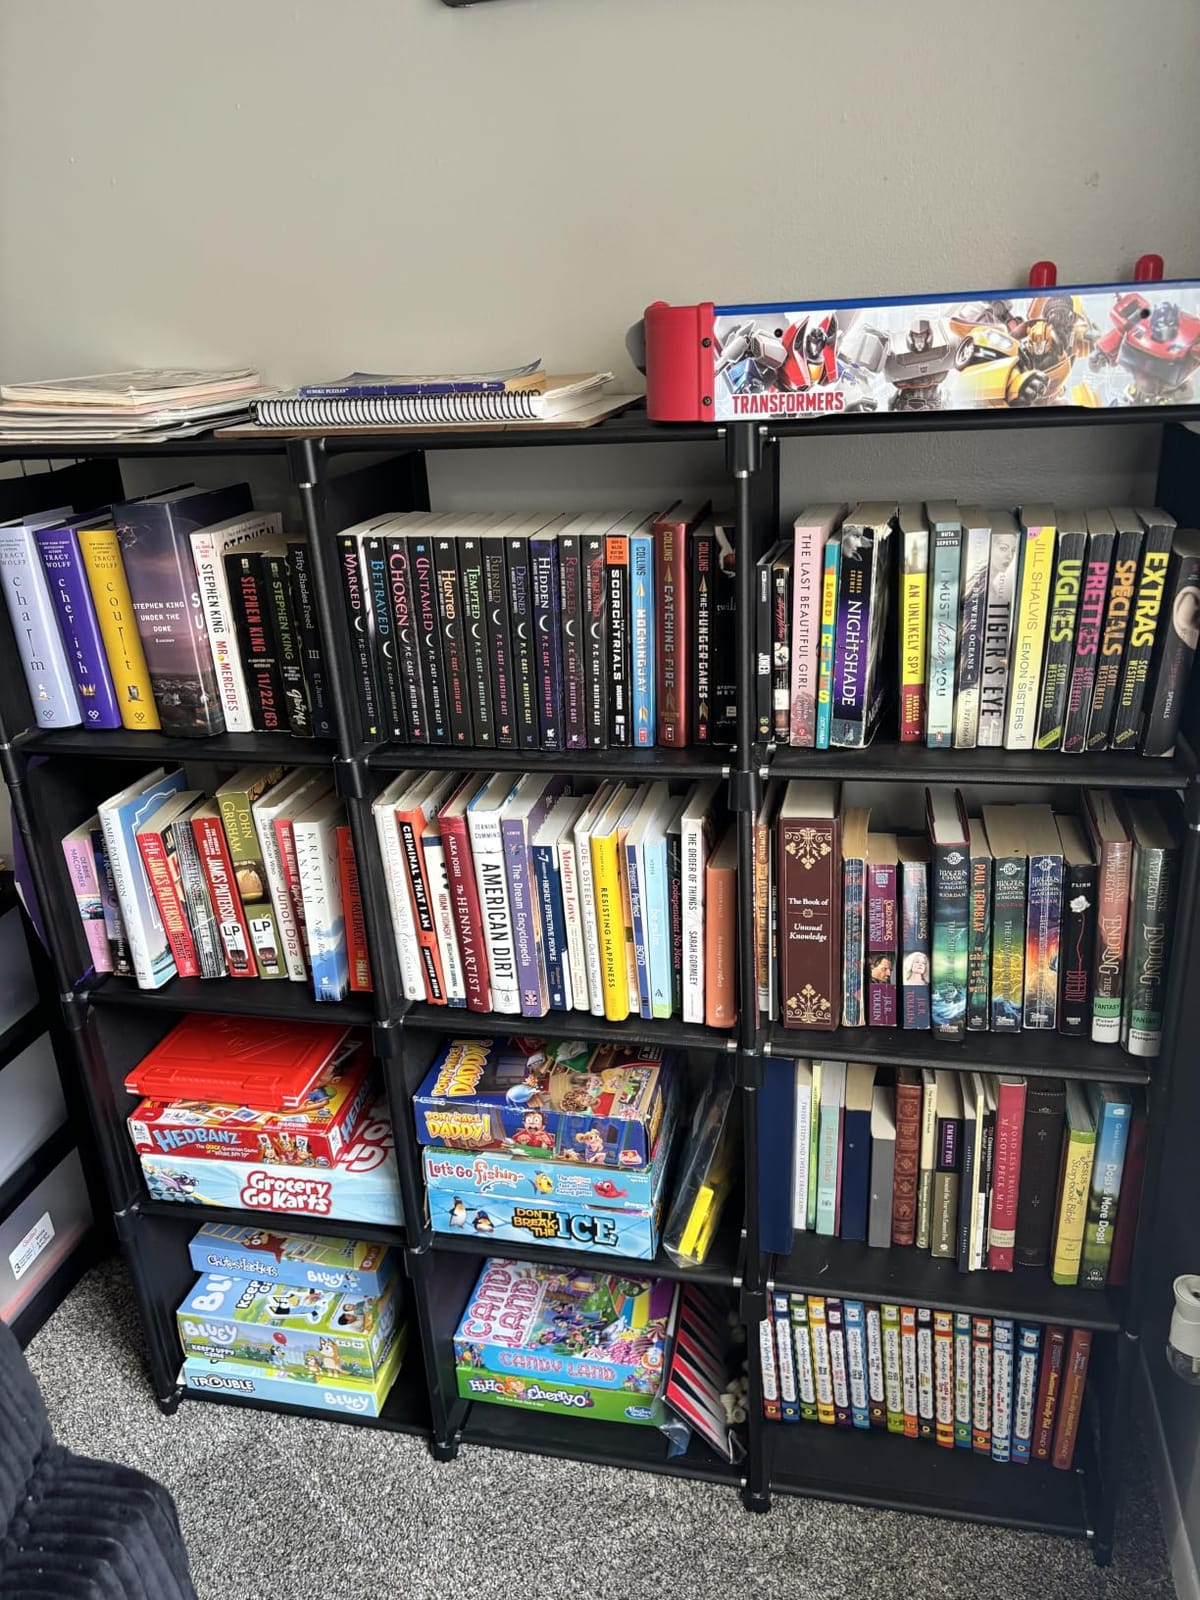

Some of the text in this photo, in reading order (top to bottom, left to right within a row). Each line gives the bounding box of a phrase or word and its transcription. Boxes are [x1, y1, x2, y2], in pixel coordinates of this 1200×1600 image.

[732, 391, 844, 414] TRANSFORMERS
[636, 546, 646, 576] COLLINS
[663, 532, 673, 562] COLLINS
[698, 542, 709, 572] COLLINS
[801, 535, 811, 557] THE
[936, 539, 959, 547] SEPETYS
[202, 563, 219, 613] STEPHEN
[344, 553, 360, 610] MARKED
[389, 553, 409, 626] CHOSEN
[416, 558, 434, 631] UNTAMED
[467, 565, 481, 619] TEMPTED
[538, 557, 551, 608] HIDDEN
[800, 563, 811, 592] LAST
[1027, 539, 1046, 631] JILL SHALVIS
[240, 576, 261, 624] STEPHEN
[370, 560, 390, 635] BETRAYED
[611, 569, 621, 629] SCORCH
[825, 583, 833, 617] LORD
[938, 582, 952, 619] MUST
[1102, 559, 1136, 656] SPECIALS
[1130, 552, 1169, 647] EXTRAS
[12, 576, 45, 671] charm
[210, 611, 225, 633] KING
[249, 624, 266, 653] KING
[272, 582, 289, 631] STEPHEN
[281, 630, 294, 660] KING
[664, 585, 674, 687] CATCHING FIRE
[799, 597, 811, 659] BEAUTIFUL
[907, 584, 920, 676] AN UNLIKELY SPY
[968, 587, 980, 670] BETWEEN OCEANS
[612, 630, 621, 681] TRIALS
[636, 609, 648, 693] MOCKINGJAY
[699, 593, 709, 699] THE HUNGER GAMES
[842, 600, 865, 706] NIGHTSHADE
[932, 621, 957, 669] betray
[216, 641, 239, 711] MR MERCEDES
[798, 664, 809, 689] GIRL
[936, 669, 947, 697] YOU
[1014, 634, 1033, 731] LEMON SISTERS
[1044, 665, 1057, 708] WESTERFELD
[1058, 664, 1067, 684] SCOTT
[1070, 667, 1084, 712] WESTERFELD
[1084, 667, 1094, 689] SCOTT
[1094, 665, 1108, 710] WESTERFELD
[1108, 665, 1118, 686] SCOTT
[1122, 659, 1138, 706] WESTERFELD
[1138, 659, 1148, 683] SCOTT
[257, 672, 278, 727] 11/22/63
[905, 693, 913, 723] STARFORD
[981, 686, 1004, 717] EYE
[1163, 691, 1174, 719] SPECIALS
[222, 801, 243, 853] GRISHAM
[237, 808, 253, 839] JOHN
[104, 817, 128, 897] JAMES PATTERSON
[207, 857, 227, 883] JAMES
[296, 834, 312, 903] HANNAH
[308, 833, 325, 904] KRISTIN
[449, 836, 461, 877] ALKA JOSHI
[580, 842, 591, 906] JOEL OSTEEN
[688, 832, 697, 911] THE ORDER OF THINGS
[148, 857, 184, 932] JAMES PATTERSON
[402, 825, 431, 928] CRIMINAL THAT AM
[562, 850, 576, 923] Modern Love
[629, 863, 641, 918] Present Perfect
[277, 886, 292, 923] Junot
[457, 895, 472, 939] HENNA
[511, 864, 532, 967] The Dream Encyclopedia
[671, 878, 680, 935] Codependent
[788, 897, 801, 905] The
[973, 864, 985, 932] PAUL TREMBLAY
[222, 926, 240, 936] LP
[254, 921, 271, 933] LP
[482, 863, 514, 980] AMERICAN DIRT
[600, 888, 616, 988] RESISTING HAPPINESS
[674, 934, 680, 946] No
[789, 932, 827, 941] Knowledge
[794, 923, 823, 931] Unusual
[463, 944, 480, 992] ARTIST
[637, 945, 645, 965] BOYD
[688, 931, 698, 986] SARAH GORMLEY
[873, 989, 881, 1021] TOLKIEN
[153, 1129, 242, 1152] HEDBANZ
[428, 1112, 492, 1139] DADDY!
[944, 1124, 954, 1164] EMMET FOX
[1000, 1132, 1008, 1162] SCOTT
[250, 1173, 329, 1196] Grocery
[428, 1159, 473, 1179] Let's Go
[1080, 1155, 1089, 1184] Jesus
[1104, 1164, 1117, 1185] Dogs
[243, 1189, 329, 1213] Go Karts
[515, 1207, 555, 1220] DON'T
[1065, 1203, 1076, 1224] Bible
[1100, 1197, 1112, 1219] More
[513, 1216, 556, 1229] BREAK
[530, 1225, 556, 1238] THE
[556, 1212, 618, 1246] ICE
[307, 1270, 344, 1288] BLUEY
[492, 1277, 542, 1348] LAND
[183, 1320, 238, 1344] BLUEY
[190, 1374, 255, 1391] TROUBLE
[500, 1352, 618, 1382] CANDY LAND
[324, 1391, 370, 1412] BLUEY
[468, 1378, 593, 1408] HiHo Cherry-O
